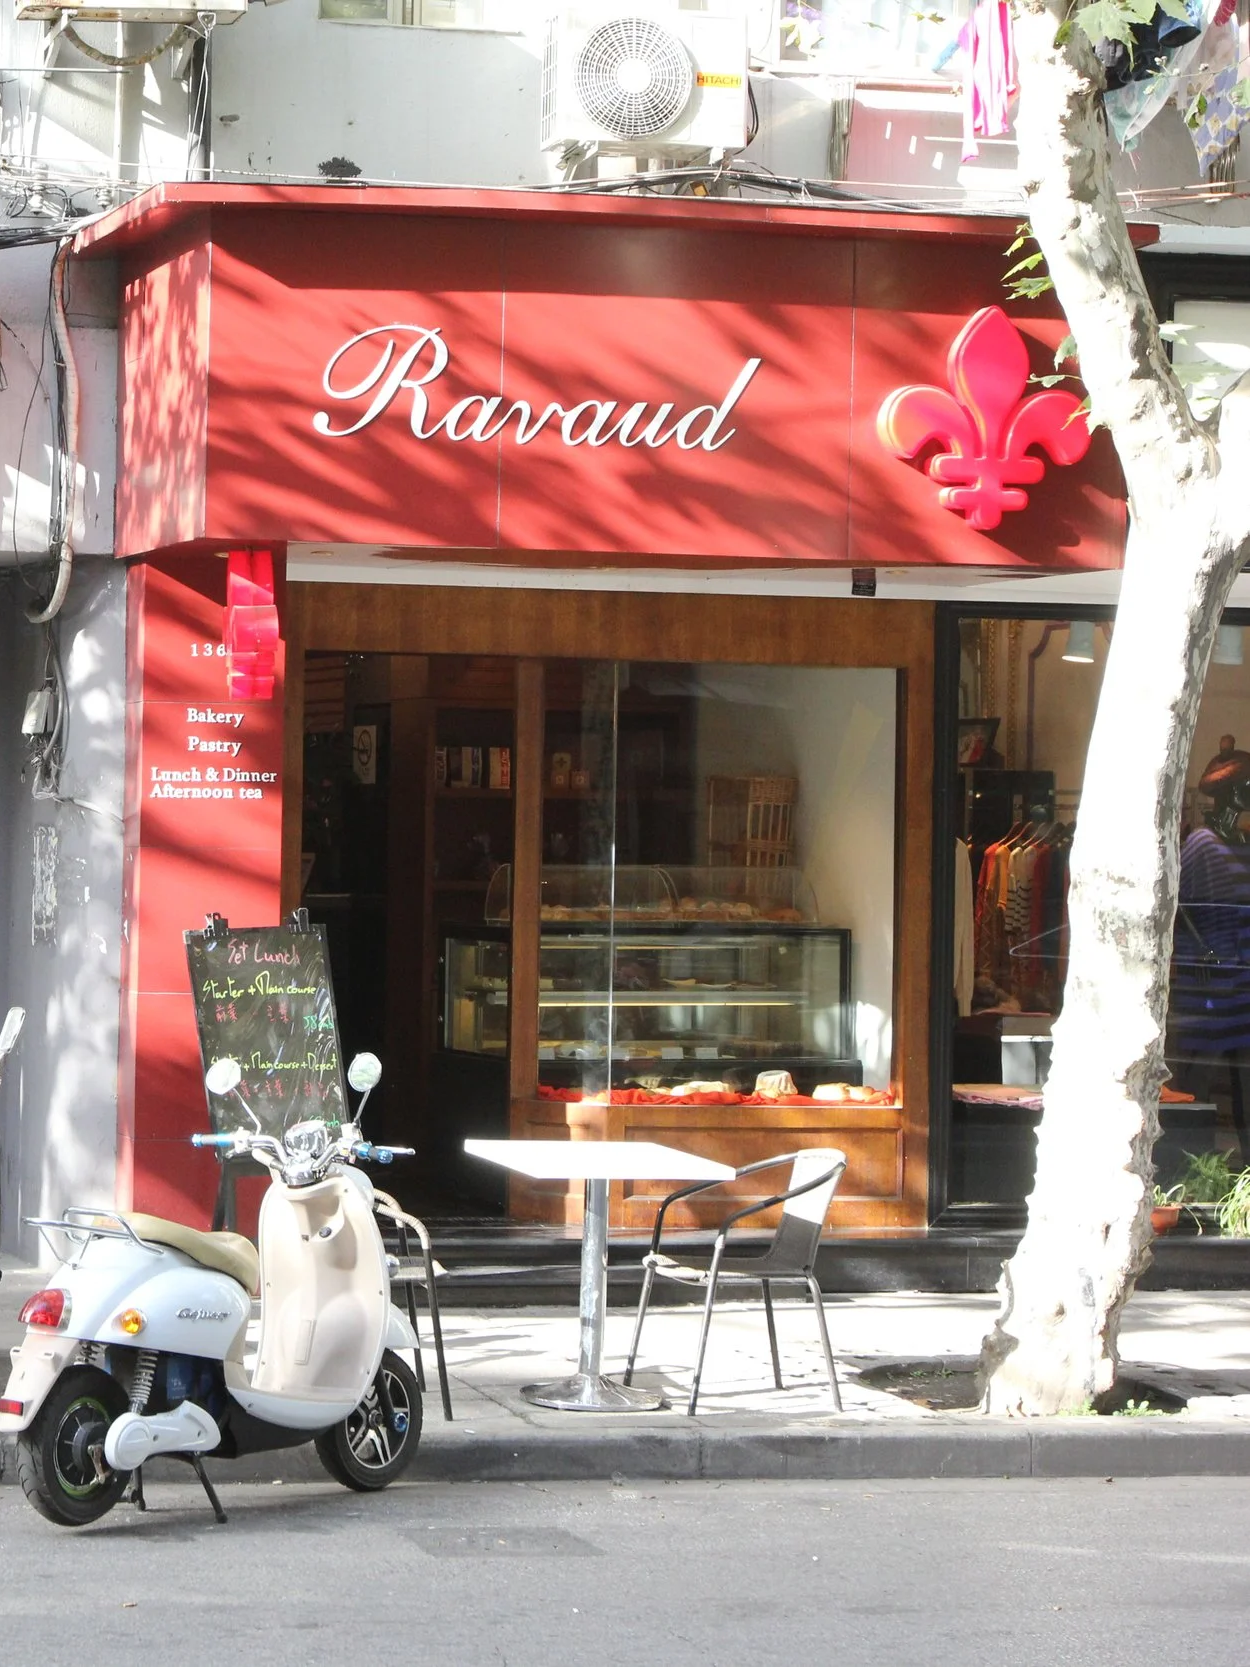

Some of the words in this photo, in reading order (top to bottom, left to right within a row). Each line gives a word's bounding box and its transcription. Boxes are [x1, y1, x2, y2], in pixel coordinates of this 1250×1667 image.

[696, 75, 742, 86] HITACHI
[313, 323, 763, 452] Ravaud
[187, 708, 244, 728] Bakery
[187, 736, 242, 757] Pastry
[151, 767, 202, 782] Lunch
[205, 767, 220, 782] &
[222, 767, 277, 783] Dinner
[150, 783, 234, 799] Afternoon
[239, 787, 263, 799] tea
[227, 938, 249, 964] Set
[254, 940, 301, 965] Lunch
[202, 976, 244, 1002] Starter
[287, 986, 317, 995] course
